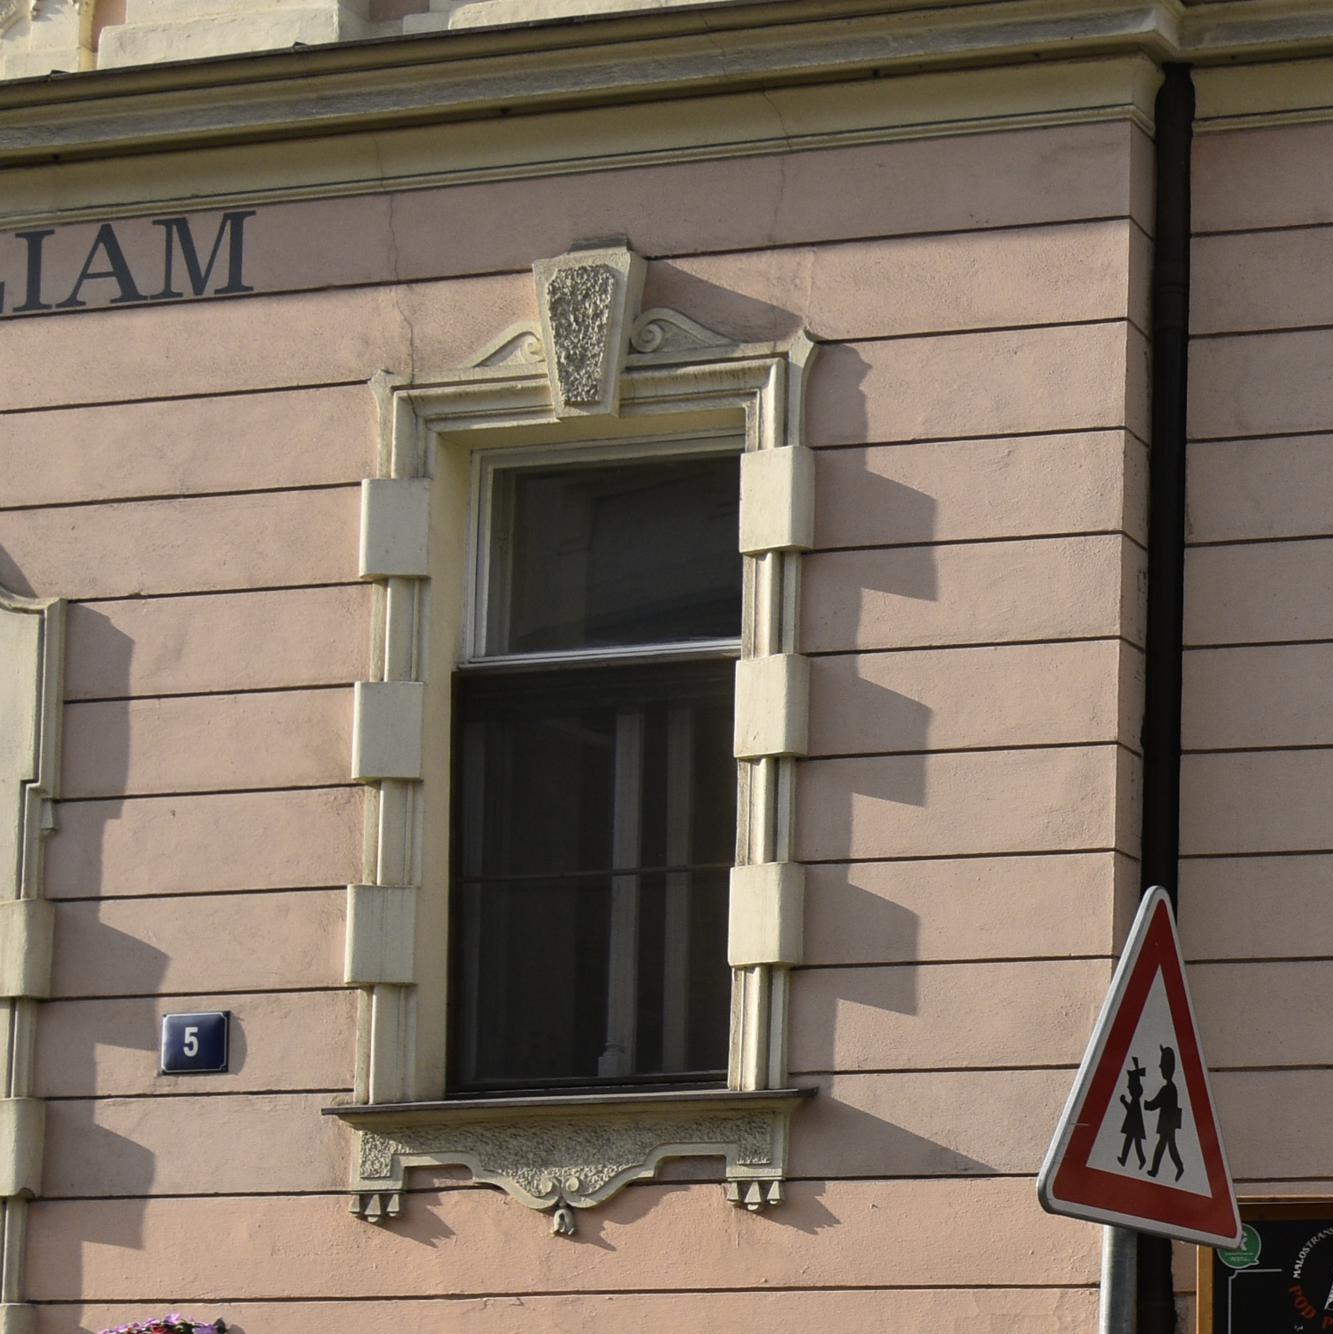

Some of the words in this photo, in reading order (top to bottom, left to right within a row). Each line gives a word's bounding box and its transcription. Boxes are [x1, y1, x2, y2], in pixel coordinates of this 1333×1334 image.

[0, 210, 256, 313] IAM
[183, 1026, 199, 1057] 5
[1288, 1283, 1318, 1321] POD
